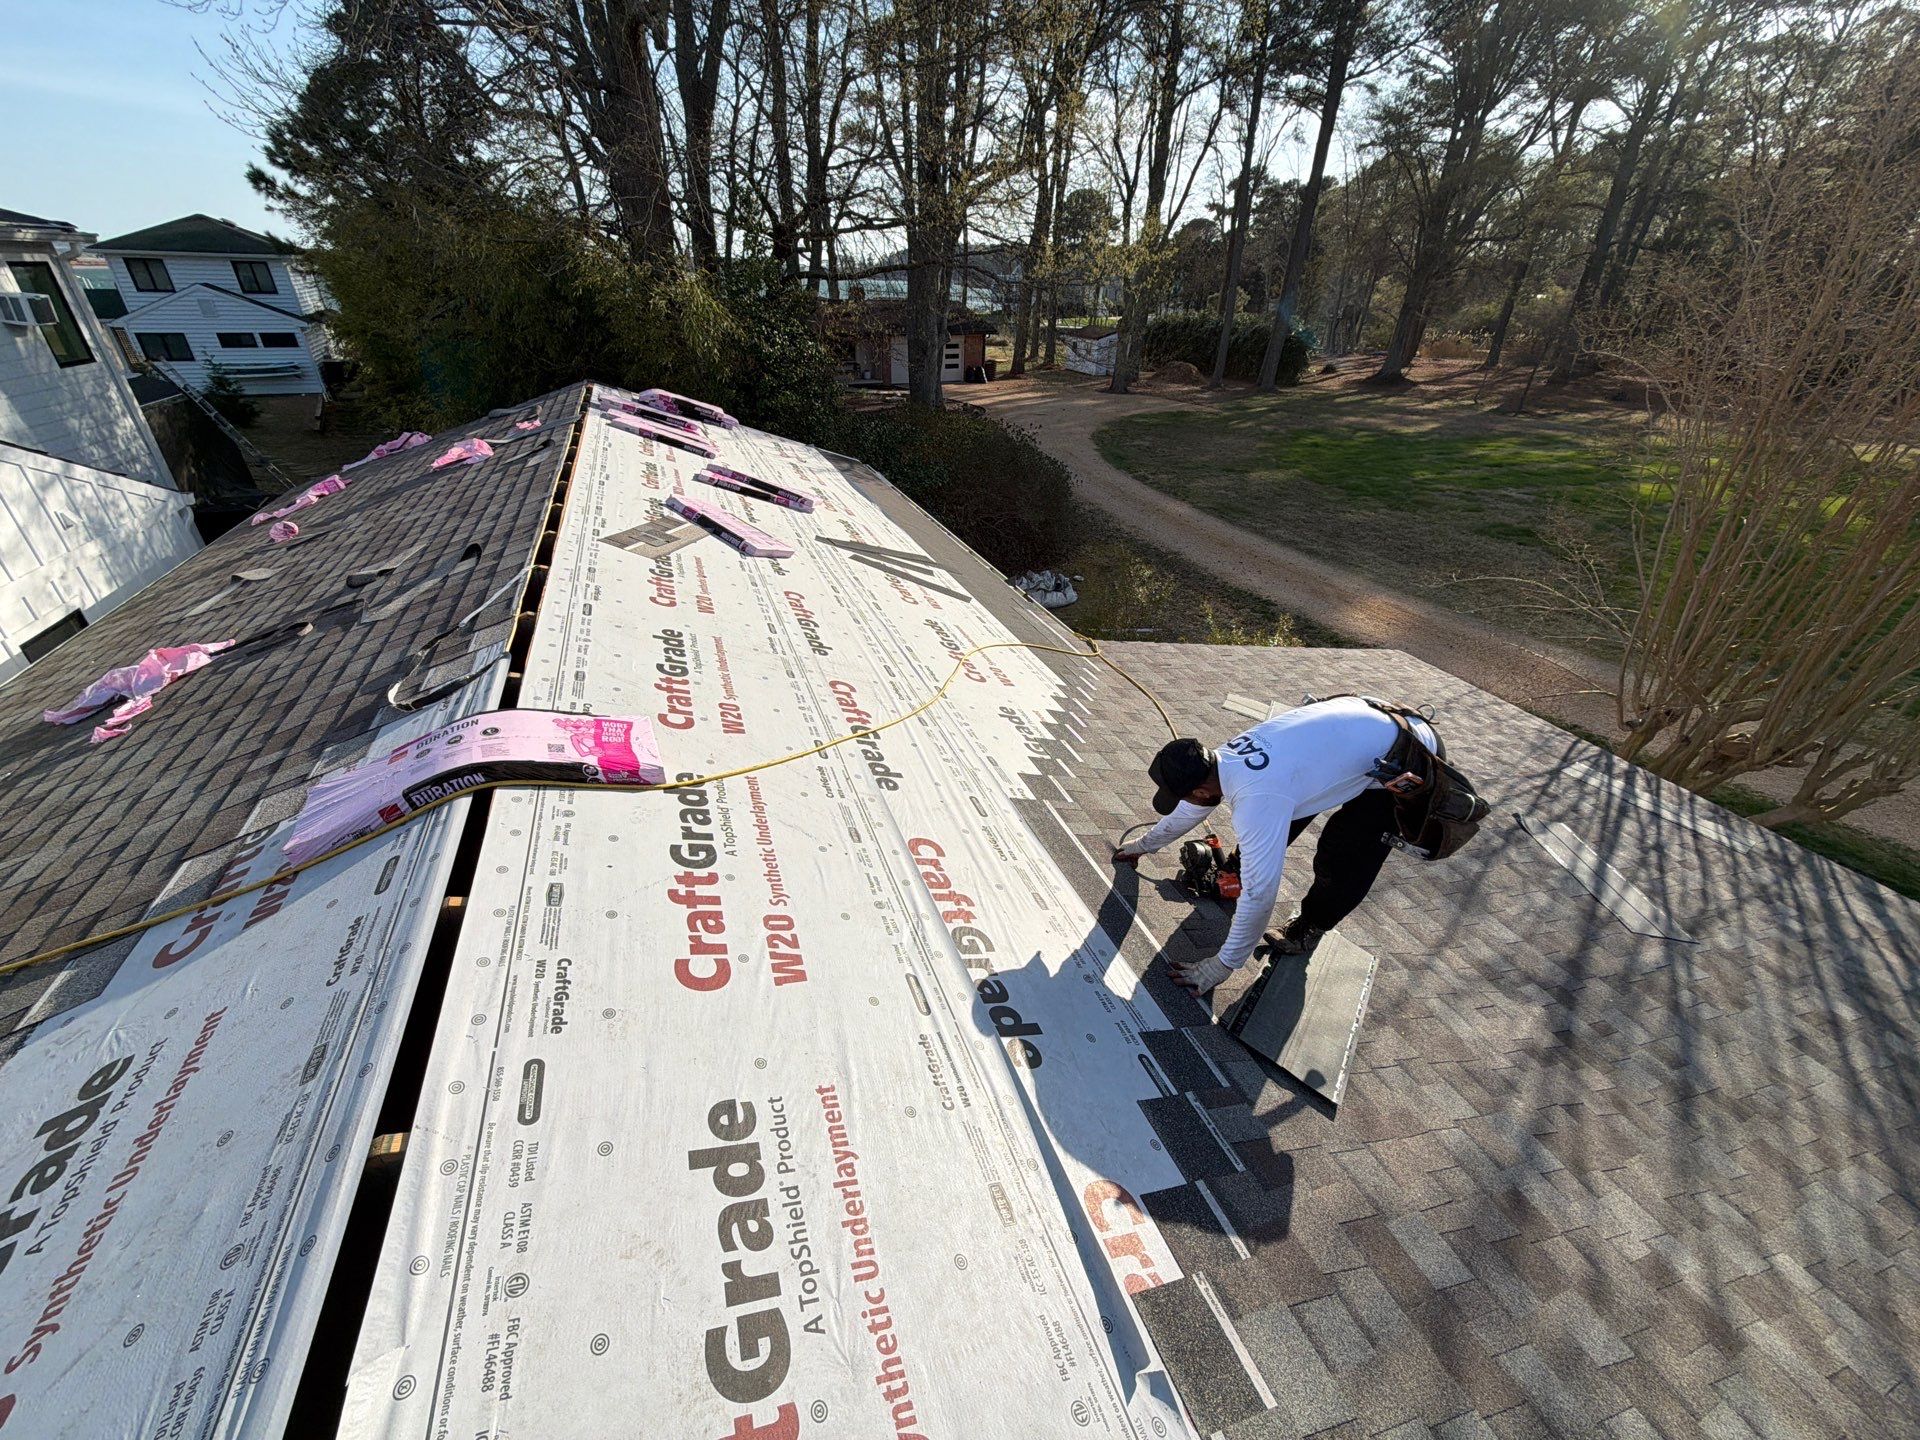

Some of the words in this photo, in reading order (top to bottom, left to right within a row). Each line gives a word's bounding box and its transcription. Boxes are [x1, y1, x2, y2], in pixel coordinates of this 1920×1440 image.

[784, 591, 833, 656] CraftGrade
[652, 629, 696, 730] CraftGrade
[719, 673, 737, 701] Synthetic
[416, 718, 479, 750] DURATION
[718, 703, 746, 735] W20
[828, 680, 904, 791] CraftGrade
[410, 771, 487, 808] DURATION
[743, 776, 773, 846] Underlayment
[720, 807, 738, 849] TopShield
[663, 772, 732, 992] CraftGrade
[759, 848, 791, 907] Synthetic
[325, 915, 365, 987] CraftGrade
[348, 954, 365, 976] W20
[762, 914, 808, 987] W20
[907, 837, 1044, 1070] CraftGrade
[535, 959, 547, 979] W20
[551, 958, 573, 1035] CraftGrade
[109, 1037, 169, 1114] Product
[918, 1033, 955, 1112] CraftGrade
[957, 1086, 972, 1109] W20
[484, 1130, 494, 1149] aware
[511, 1140, 525, 1160] CCRR
[526, 1142, 540, 1155] TDI
[767, 1095, 796, 1174] Product
[458, 1154, 472, 1180] PLASTIC
[479, 1163, 491, 1175] slip
[482, 1149, 493, 1163] that
[524, 1156, 537, 1182] Listed
[3, 1190, 129, 1375] Synthetic
[103, 1005, 229, 1194] Underlayment
[35, 1119, 120, 1237] TopShield
[456, 1180, 467, 1194] CAP
[508, 1161, 522, 1188] #0439
[814, 1084, 881, 1284] Underlayment
[239, 1208, 255, 1229] FBC
[247, 1164, 273, 1208] Approved
[451, 1195, 464, 1215] NAILS
[475, 1175, 488, 1208] resistance
[470, 1208, 481, 1224] may
[501, 1211, 516, 1240] CLASS
[518, 1202, 533, 1227] ASTM
[24, 1235, 53, 1256] A
[445, 1221, 460, 1253] ROOFING
[467, 1224, 479, 1240] vary
[499, 1242, 512, 1250] A
[515, 1229, 530, 1254] E108
[440, 1254, 453, 1278] NAILS
[463, 1241, 478, 1282] dependent
[461, 1283, 470, 1294] on
[492, 1275, 502, 1303] Intertek
[188, 1318, 211, 1354] ASTM
[202, 1288, 223, 1318] E108
[209, 1298, 232, 1336] CLASS
[453, 1294, 468, 1332] weather,
[505, 1317, 522, 1340] FBC
[802, 1314, 826, 1336] A
[449, 1332, 463, 1365] surface
[1037, 1314, 1063, 1361] Approved
[1052, 1320, 1078, 1368] #FL46488
[1085, 1341, 1102, 1367] surface
[231, 1356, 255, 1399] PLASTIC
[480, 1332, 502, 1393] #FL46488
[498, 1341, 519, 1402] Approved
[1056, 1360, 1071, 1382] FBC
[160, 1380, 187, 1423] Listed
[181, 1366, 206, 1408] #0439
[440, 1366, 456, 1416] conditions
[1110, 1402, 1119, 1413] on
